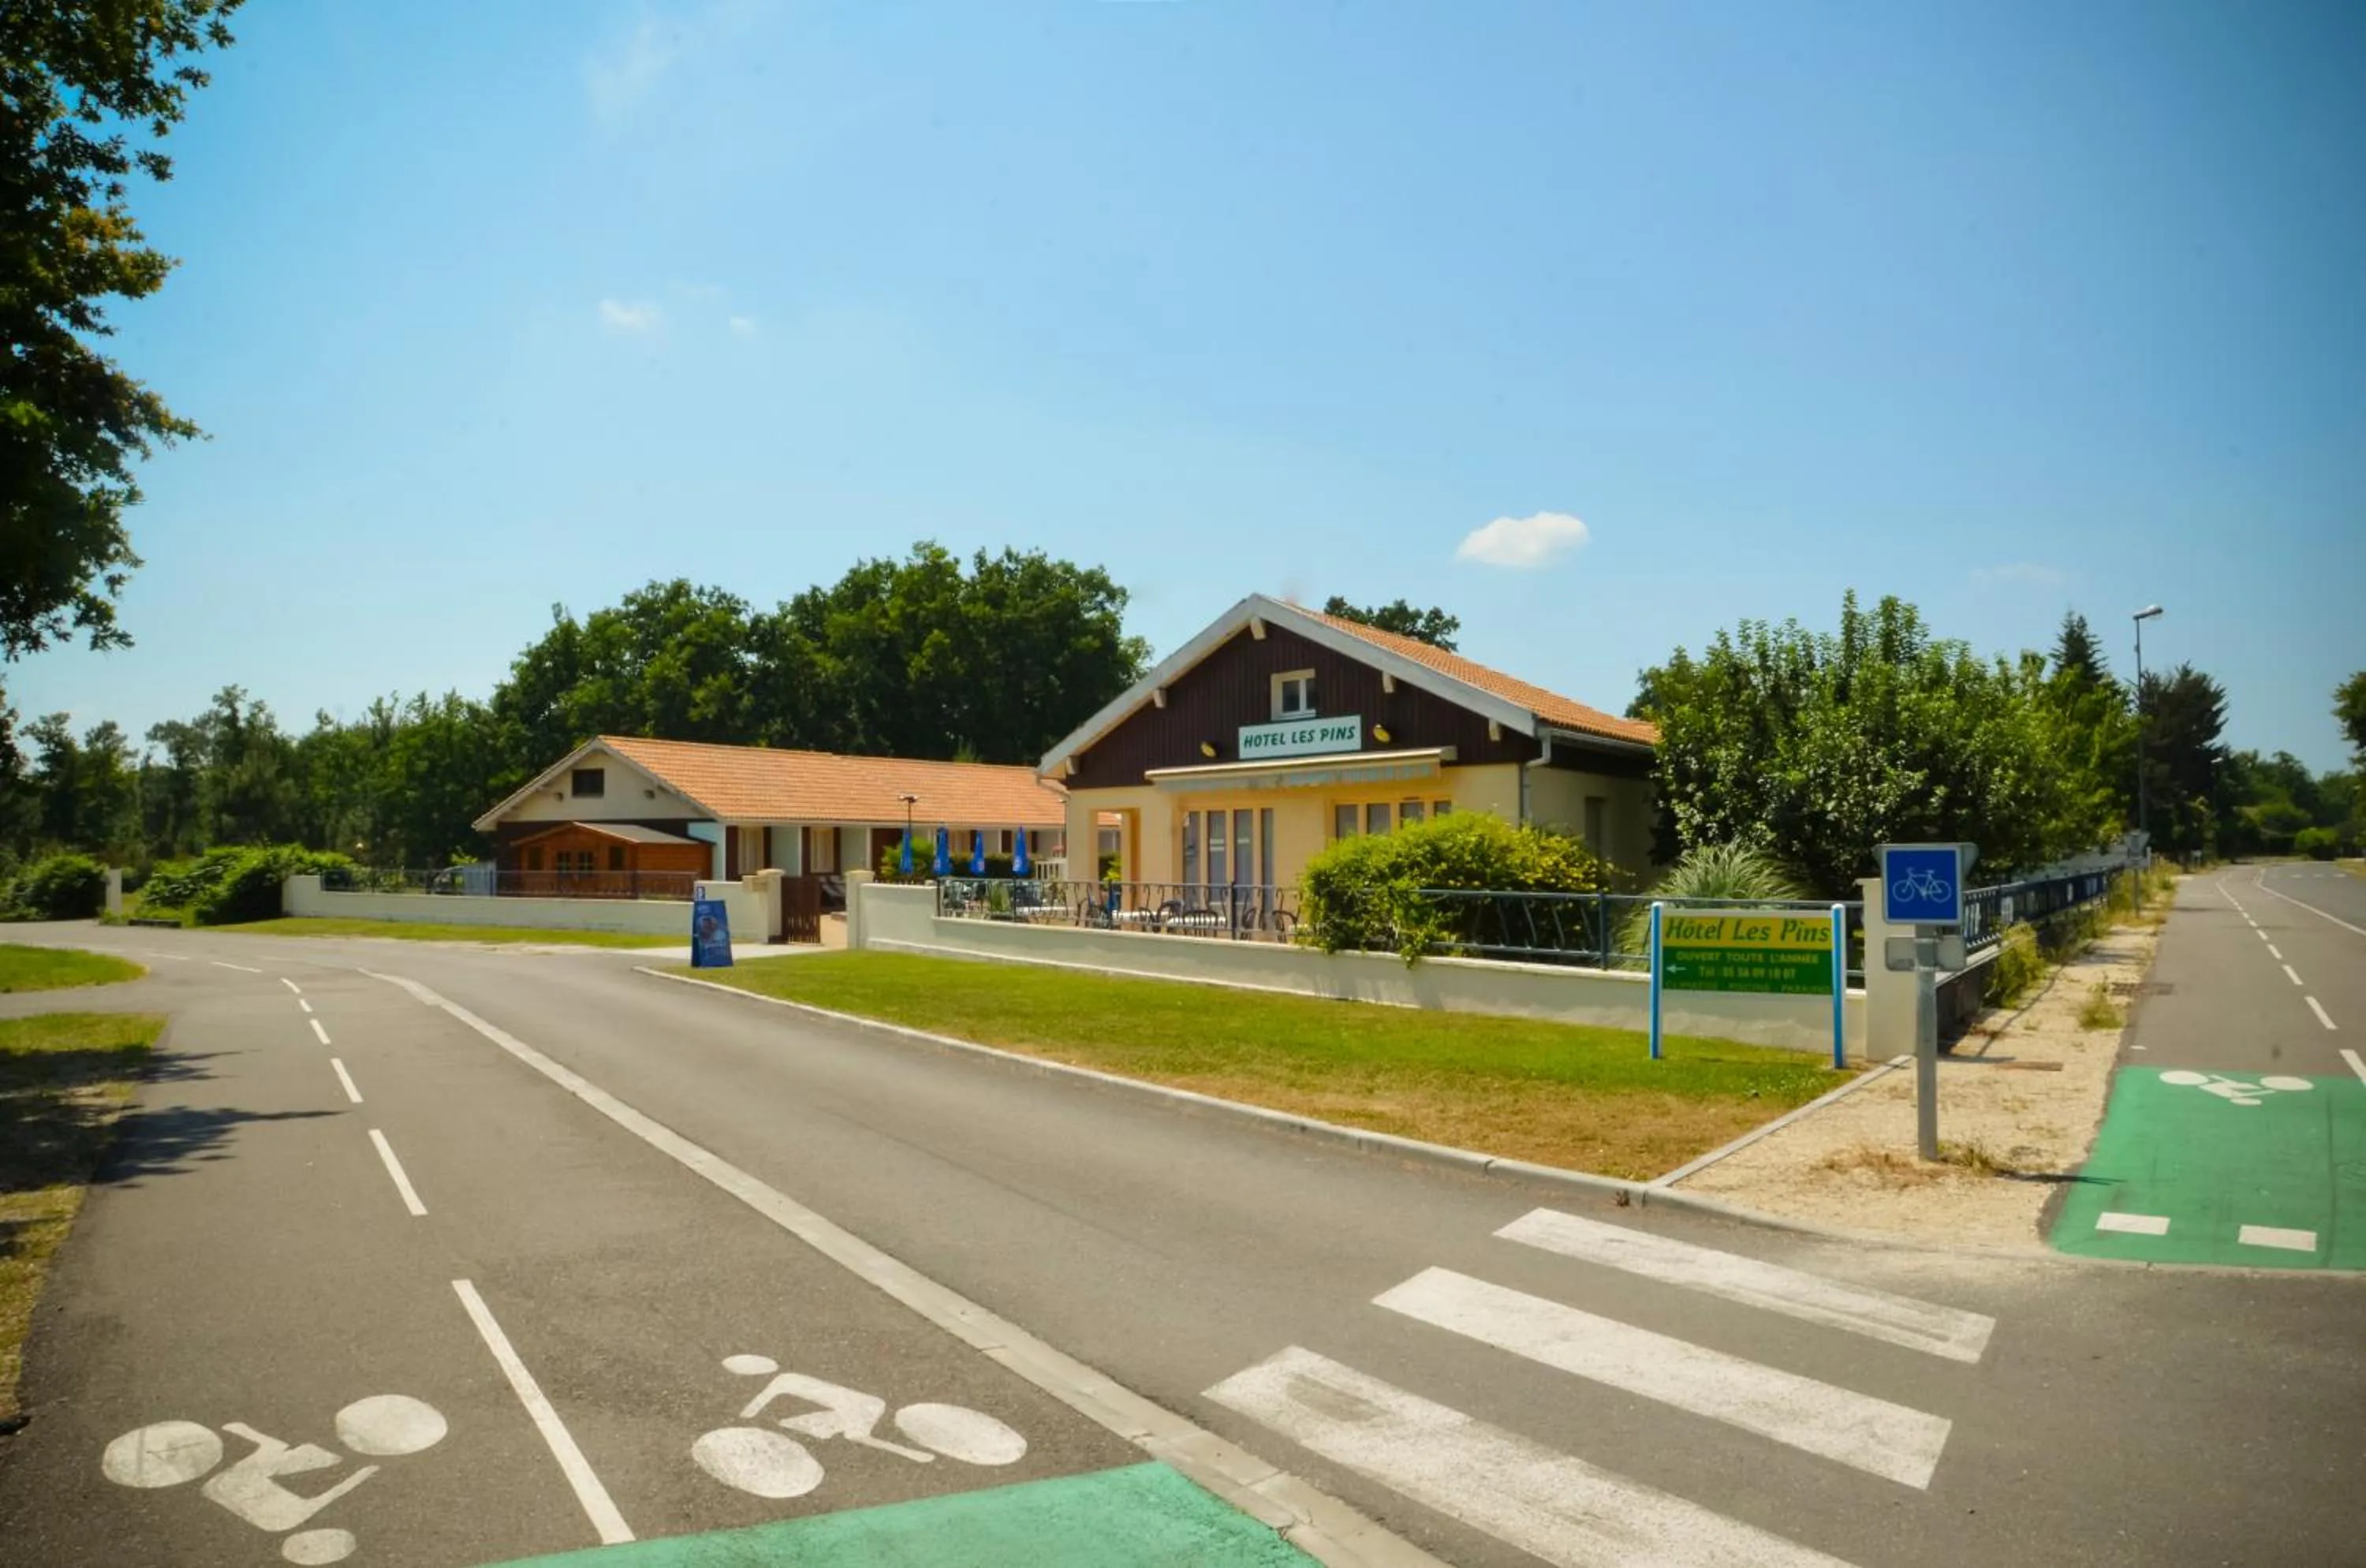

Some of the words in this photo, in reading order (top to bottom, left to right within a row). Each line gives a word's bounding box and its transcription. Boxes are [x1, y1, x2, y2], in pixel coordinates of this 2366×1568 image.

[1244, 732, 1286, 748] HOTEL
[1292, 729, 1317, 744] LES
[1320, 726, 1357, 742] PINS
[1733, 919, 1771, 942] Les
[1780, 919, 1830, 943] Pins
[1676, 950, 1721, 961] OUVERT
[1726, 952, 1764, 963] TOUTE
